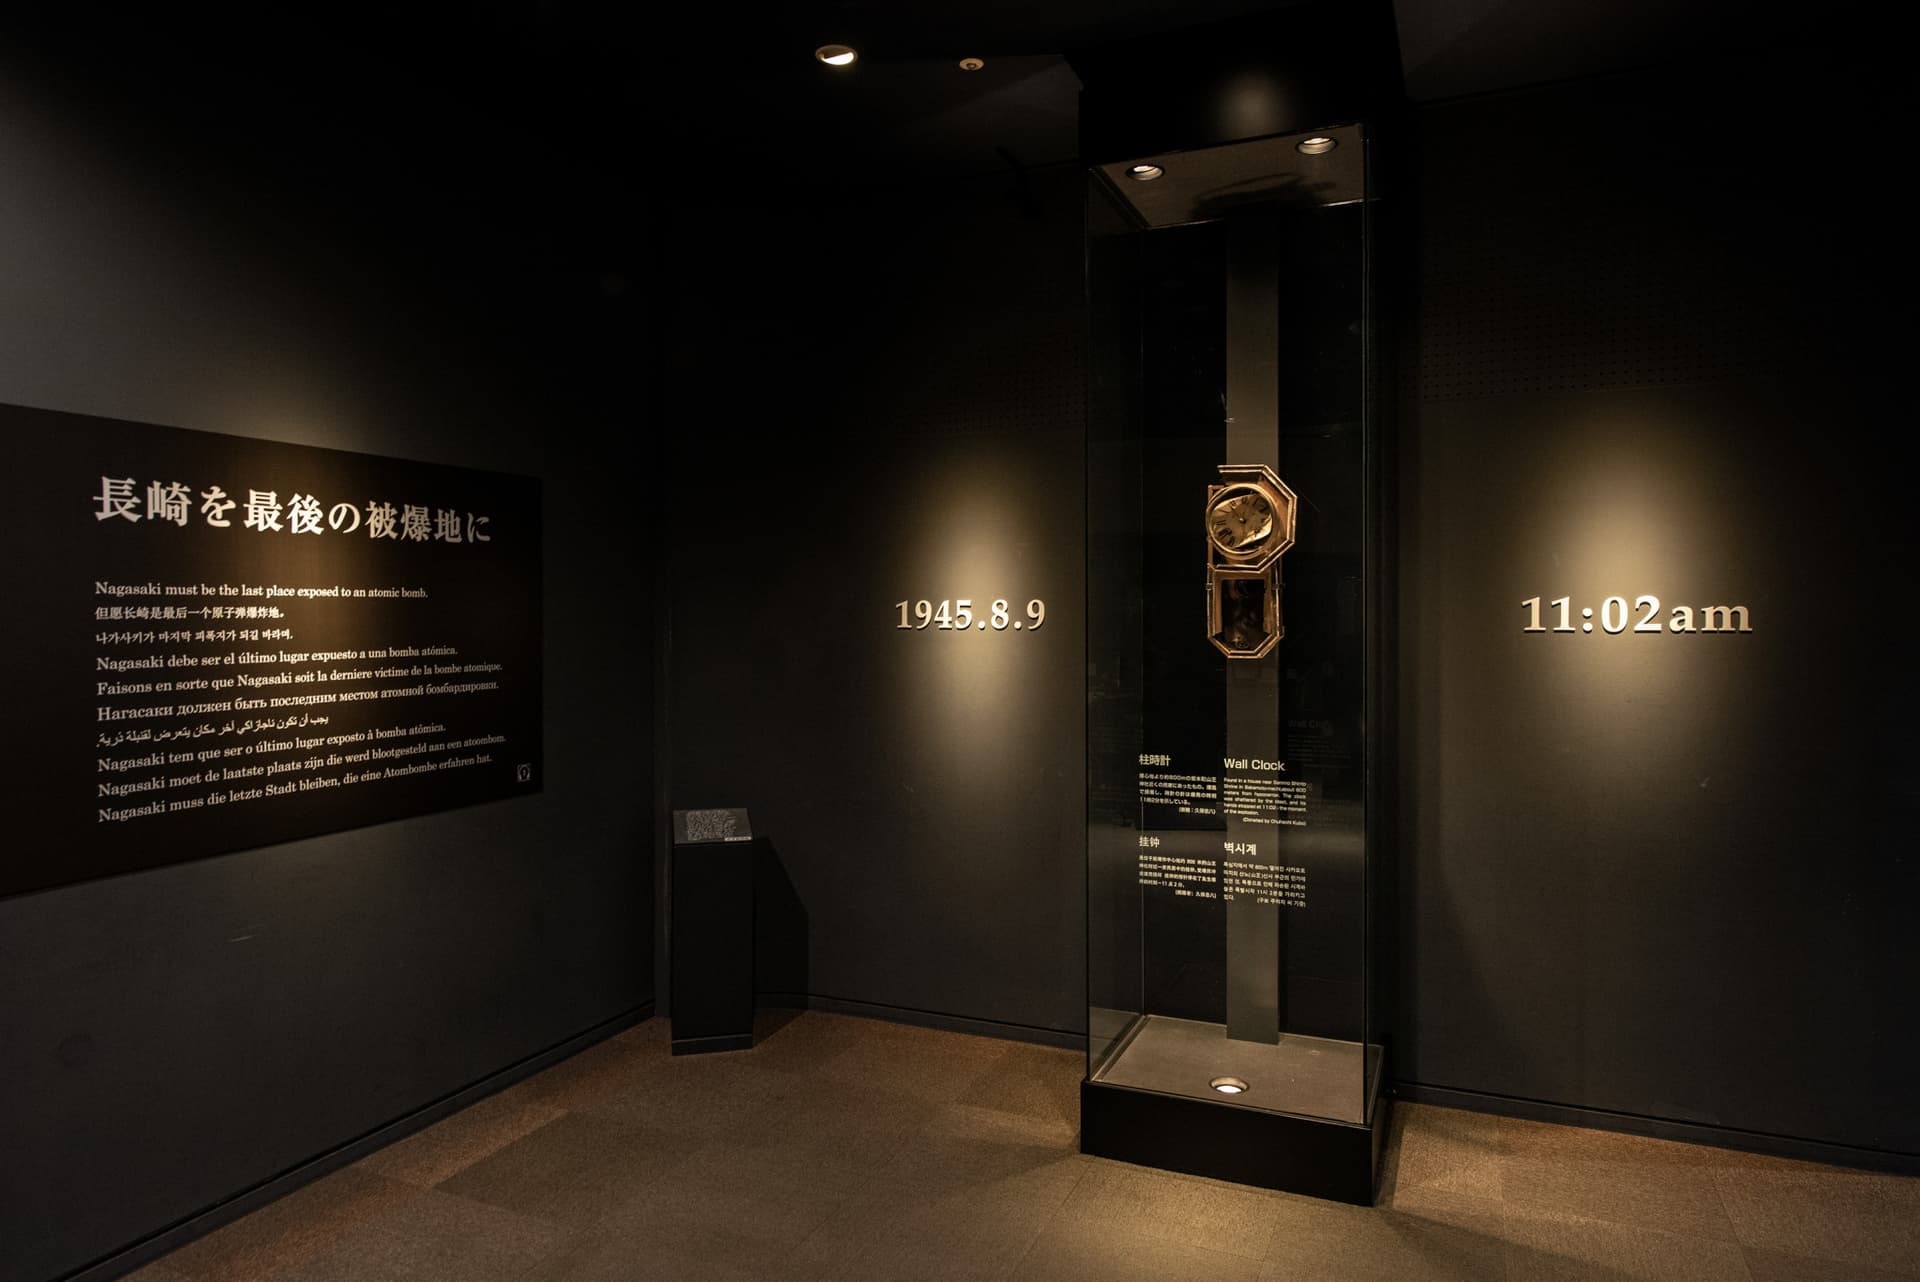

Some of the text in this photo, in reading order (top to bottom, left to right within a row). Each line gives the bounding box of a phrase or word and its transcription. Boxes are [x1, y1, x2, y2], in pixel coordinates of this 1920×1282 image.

[93, 476, 491, 544] 長崎を最後の被爆地に
[95, 581, 428, 599] Nagasaki must be the last place exposed to an atomic bomb.
[895, 599, 1046, 630] 1945.8.9
[1521, 595, 1753, 633] 11:02am
[96, 632, 154, 645] 나가사키가
[159, 631, 192, 642] 마지막
[97, 655, 163, 671] Nagasaki
[168, 655, 199, 667] debe
[201, 655, 221, 665] ser
[224, 653, 235, 665] el
[238, 653, 276, 664] último
[279, 651, 308, 665] lugar
[311, 650, 357, 662] expuesto
[368, 650, 387, 658] una
[389, 647, 419, 657] bomba
[421, 645, 458, 656] atómica.
[97, 661, 503, 696] Faisons en sorte que Nagasaki soit la derniere victime de la bombe atomique.
[98, 705, 173, 721] Нагасаки
[176, 703, 231, 716] должен
[235, 698, 267, 709] быть
[270, 695, 336, 707] последним
[339, 690, 379, 700] местом
[381, 683, 424, 698] атомной
[299, 713, 309, 727] أن
[310, 715, 329, 726] يجب
[98, 751, 164, 773] Nagasaki
[169, 750, 194, 763] tem
[197, 749, 221, 762] que
[224, 746, 243, 756] ser
[246, 746, 253, 754] o
[256, 740, 293, 753] último
[295, 737, 325, 749] lugar
[327, 732, 365, 746] exposto
[376, 726, 407, 738] bomba
[1139, 754, 1171, 766] 柱時計
[98, 775, 165, 797] Nagasaki
[169, 773, 202, 788] moet
[205, 770, 220, 782] de
[223, 765, 264, 781] laatste
[267, 761, 302, 777] plaats
[304, 758, 324, 770] zijn
[327, 753, 342, 765] die
[345, 749, 370, 763] werd
[372, 742, 427, 761] blootgesteld
[429, 742, 445, 751] aan
[447, 740, 462, 749] een
[1224, 758, 1286, 771] Wall Clock
[99, 754, 493, 822] Nagasaki muss die letzte Stadt bleiben, die eine Atombombe erfahren hat.
[1139, 836, 1160, 848] 挂钟
[1224, 842, 1256, 855] 벽시계
